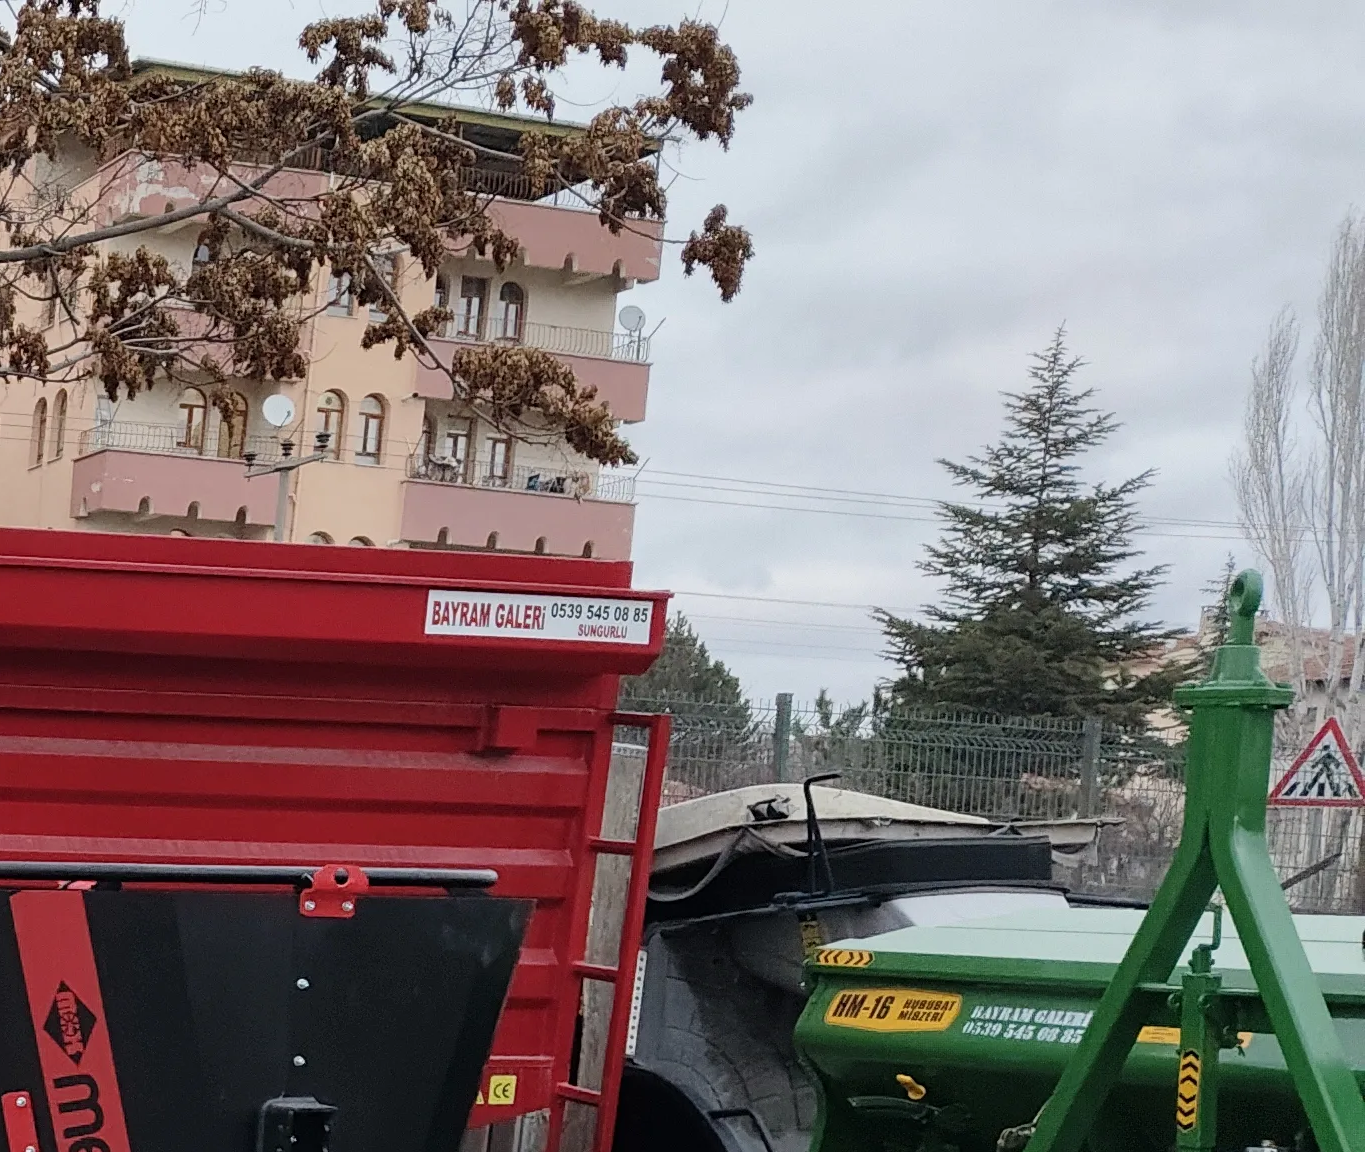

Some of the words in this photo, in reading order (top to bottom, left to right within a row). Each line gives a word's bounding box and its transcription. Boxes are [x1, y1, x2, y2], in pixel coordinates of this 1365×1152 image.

[431, 600, 491, 627] BAYRAM
[551, 602, 582, 620] 0539
[586, 604, 610, 621] 545
[614, 606, 629, 622] 08
[633, 607, 649, 623] 85
[577, 624, 628, 639] SUNGURLU
[832, 994, 896, 1020] HM-16
[903, 999, 957, 1011] HUBUBAT
[962, 1021, 1002, 1037] 0539
[1003, 1023, 1036, 1040] 545
[1059, 1029, 1086, 1044] 85
[493, 1083, 511, 1099] CE
